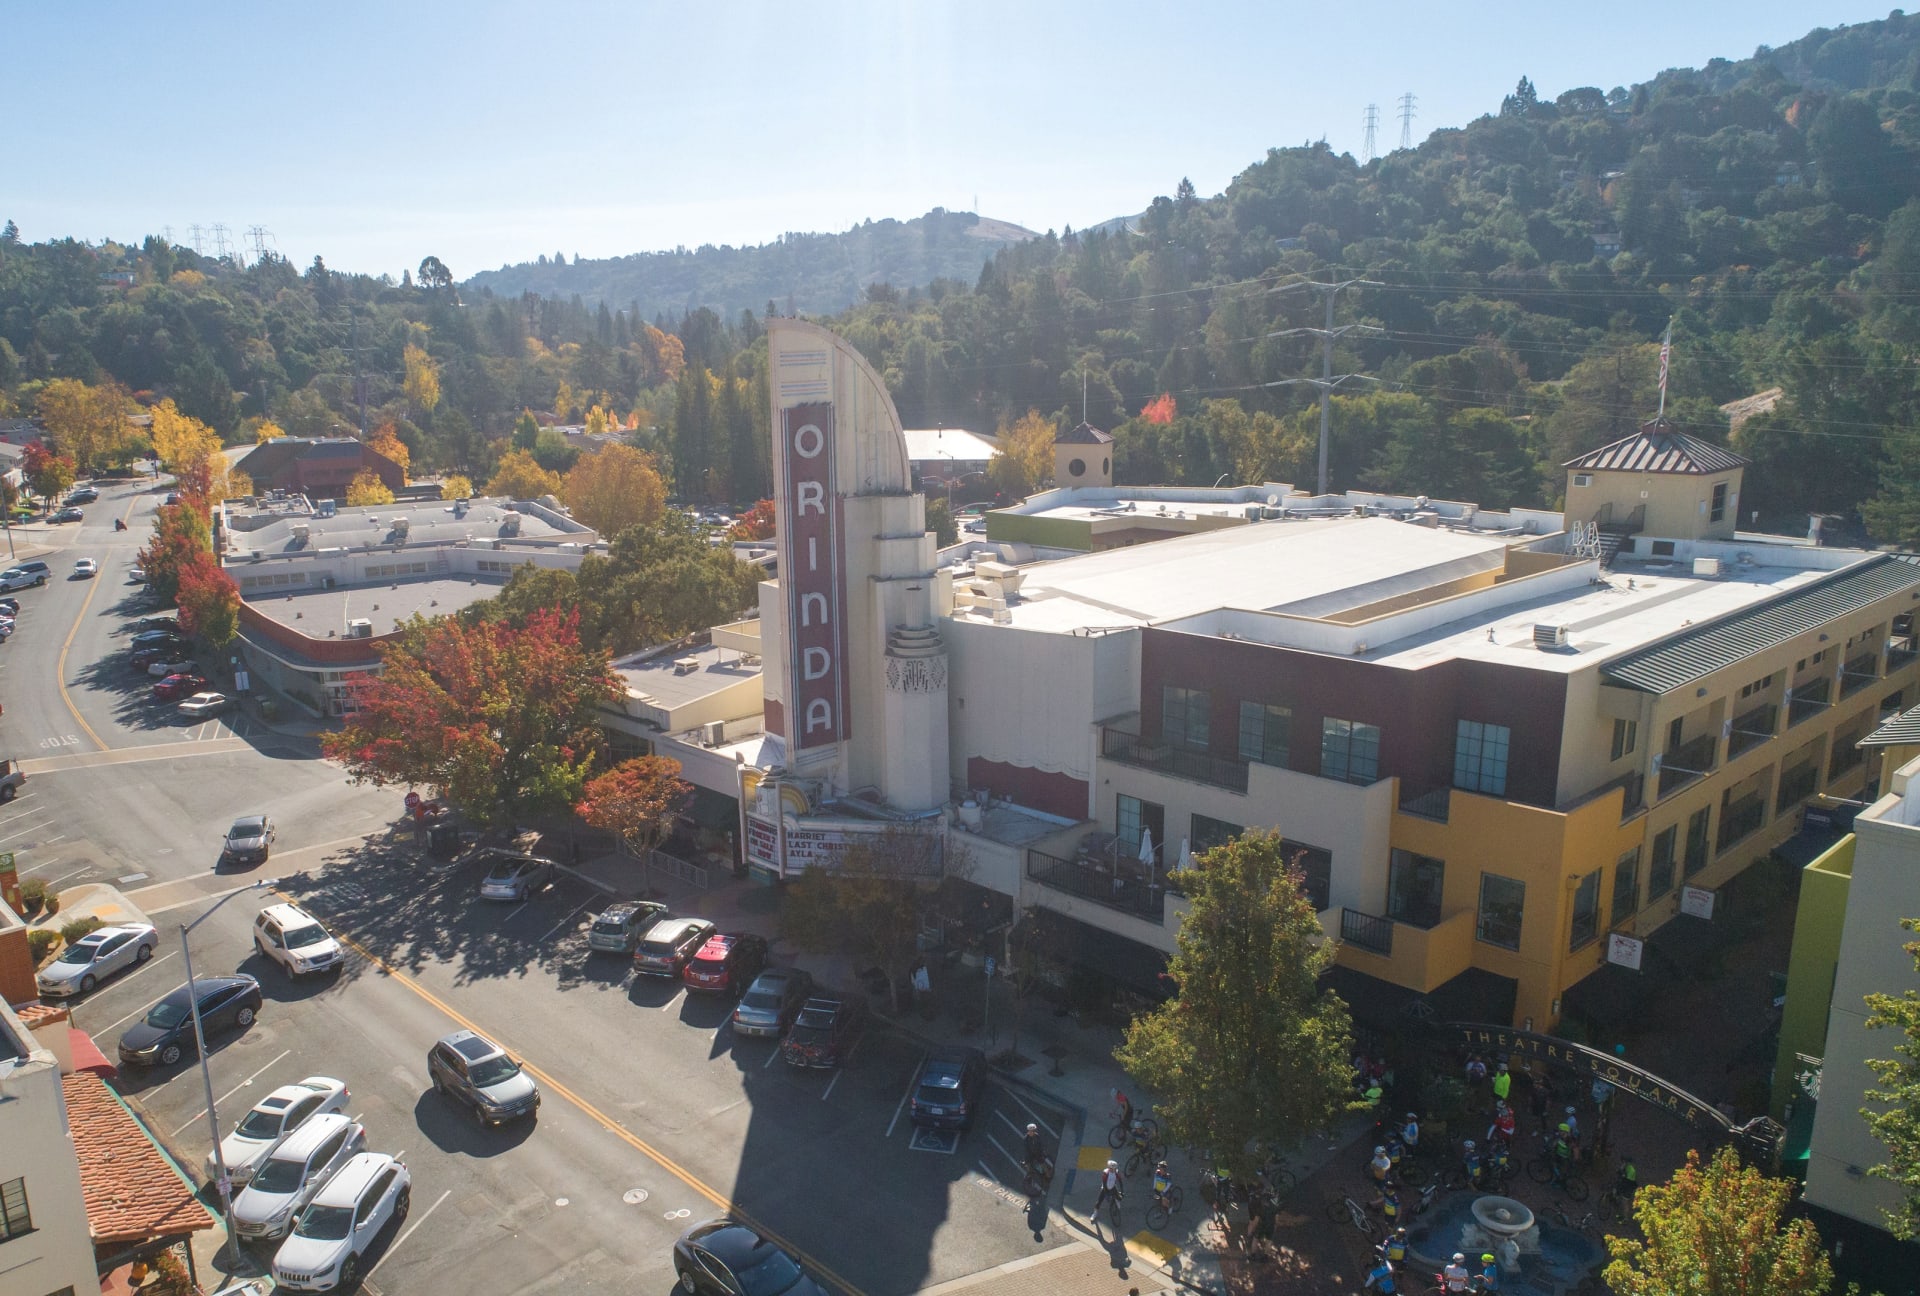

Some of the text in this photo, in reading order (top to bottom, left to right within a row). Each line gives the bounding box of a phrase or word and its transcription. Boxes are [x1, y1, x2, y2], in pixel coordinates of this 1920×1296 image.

[40, 734, 80, 748] STOP
[787, 831, 826, 840] HARRIET
[789, 841, 851, 851] LAST CHRIST
[1463, 1030, 1698, 1122] THEATRE SQUARE
